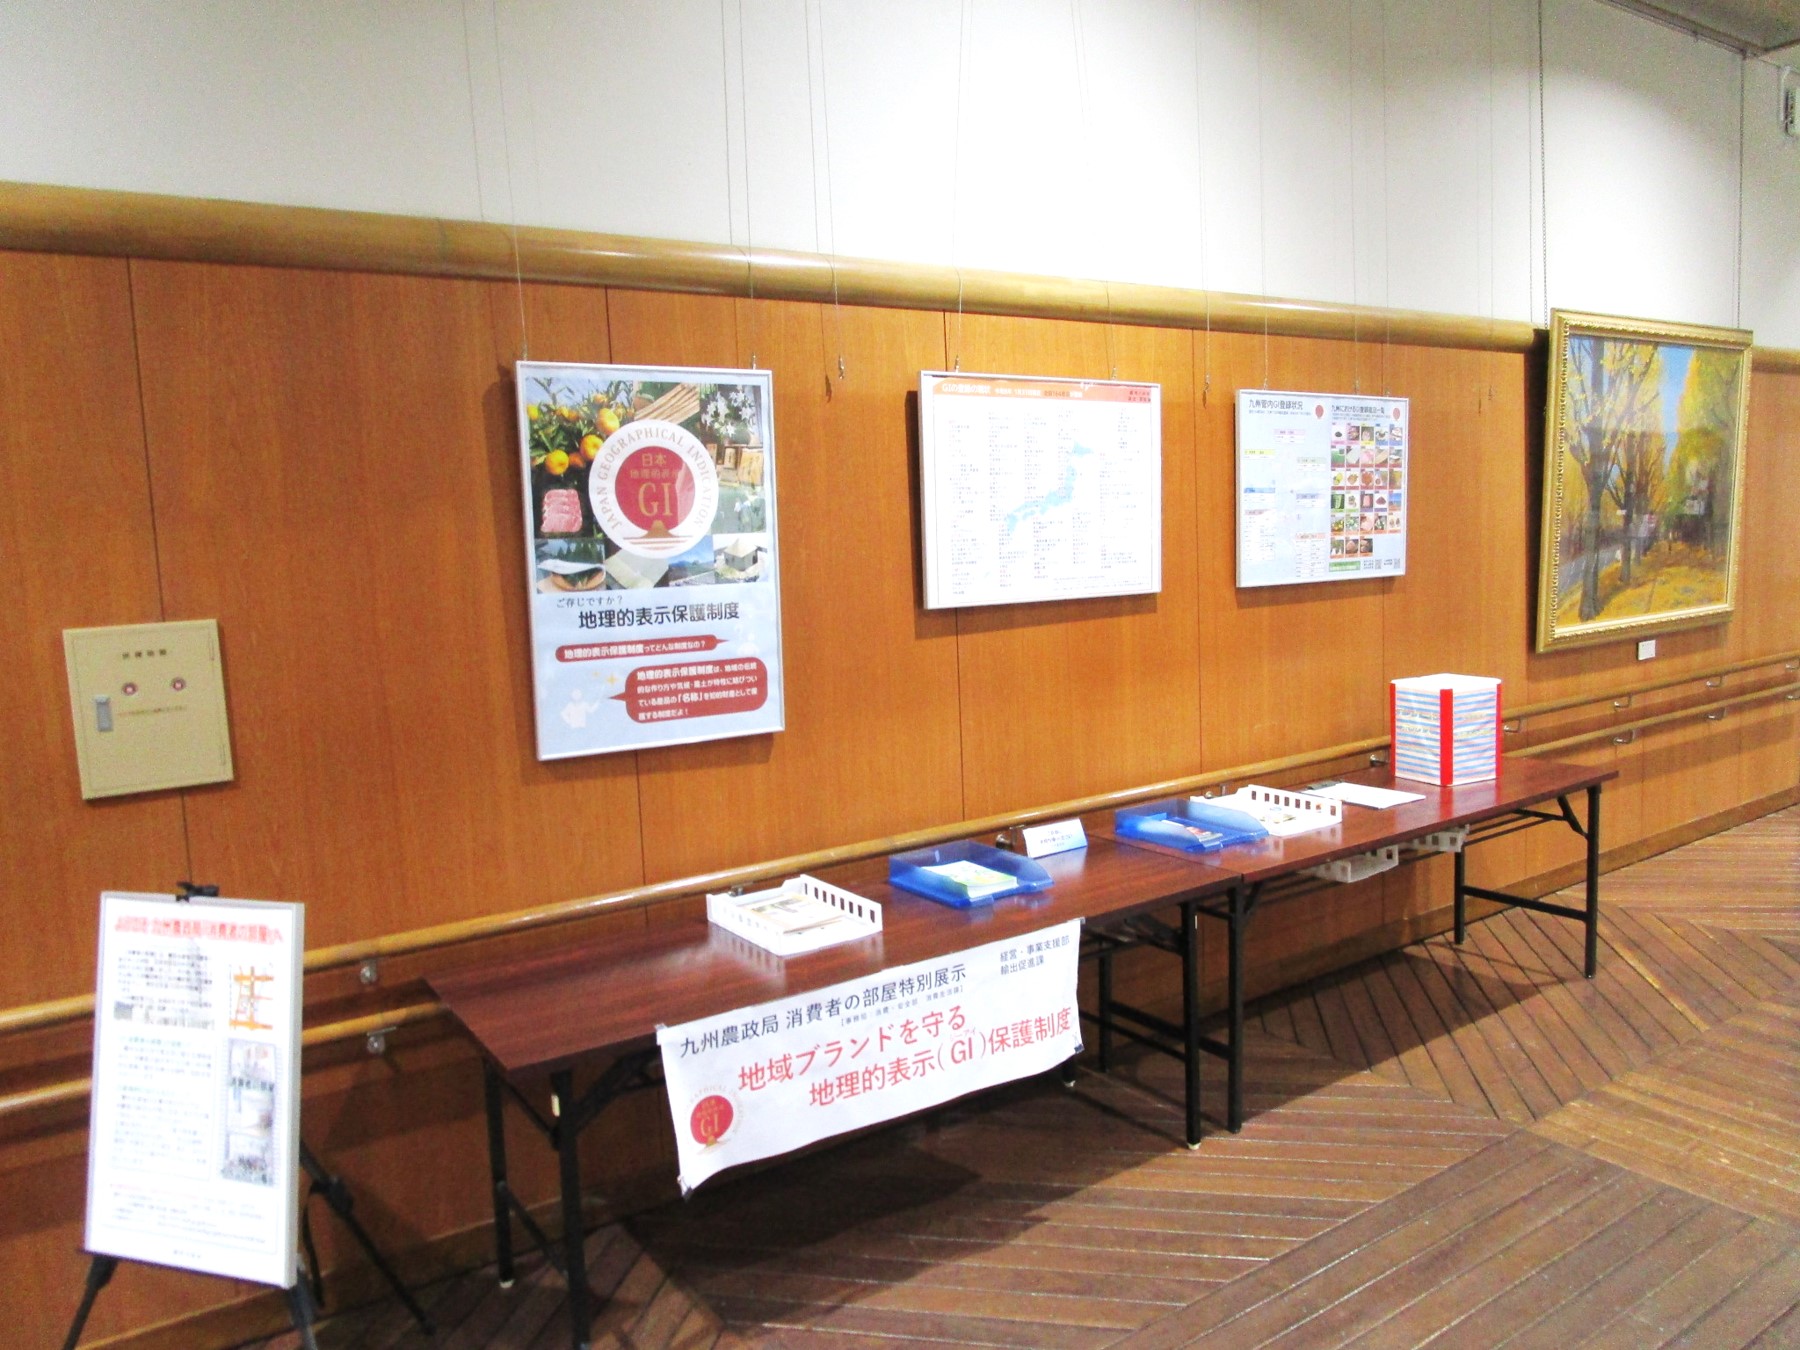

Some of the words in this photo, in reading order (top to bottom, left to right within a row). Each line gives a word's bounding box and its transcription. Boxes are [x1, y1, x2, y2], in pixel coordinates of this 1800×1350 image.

[598, 427, 684, 481] GEOGRAPHICAL
[641, 452, 667, 468] 日本
[597, 486, 622, 530] JAPAN
[638, 482, 673, 517] GI
[556, 595, 624, 609] ご存じですか？
[578, 602, 740, 630] 地理的表示保護制度
[1000, 935, 1071, 963] 経営・事業支援部
[1000, 956, 1046, 977] 輸出促進課
[679, 1009, 779, 1059] 九州農政局
[785, 963, 967, 1031] 消費者の部屋特別展示
[738, 1004, 968, 1093] 地域ブランドを守る
